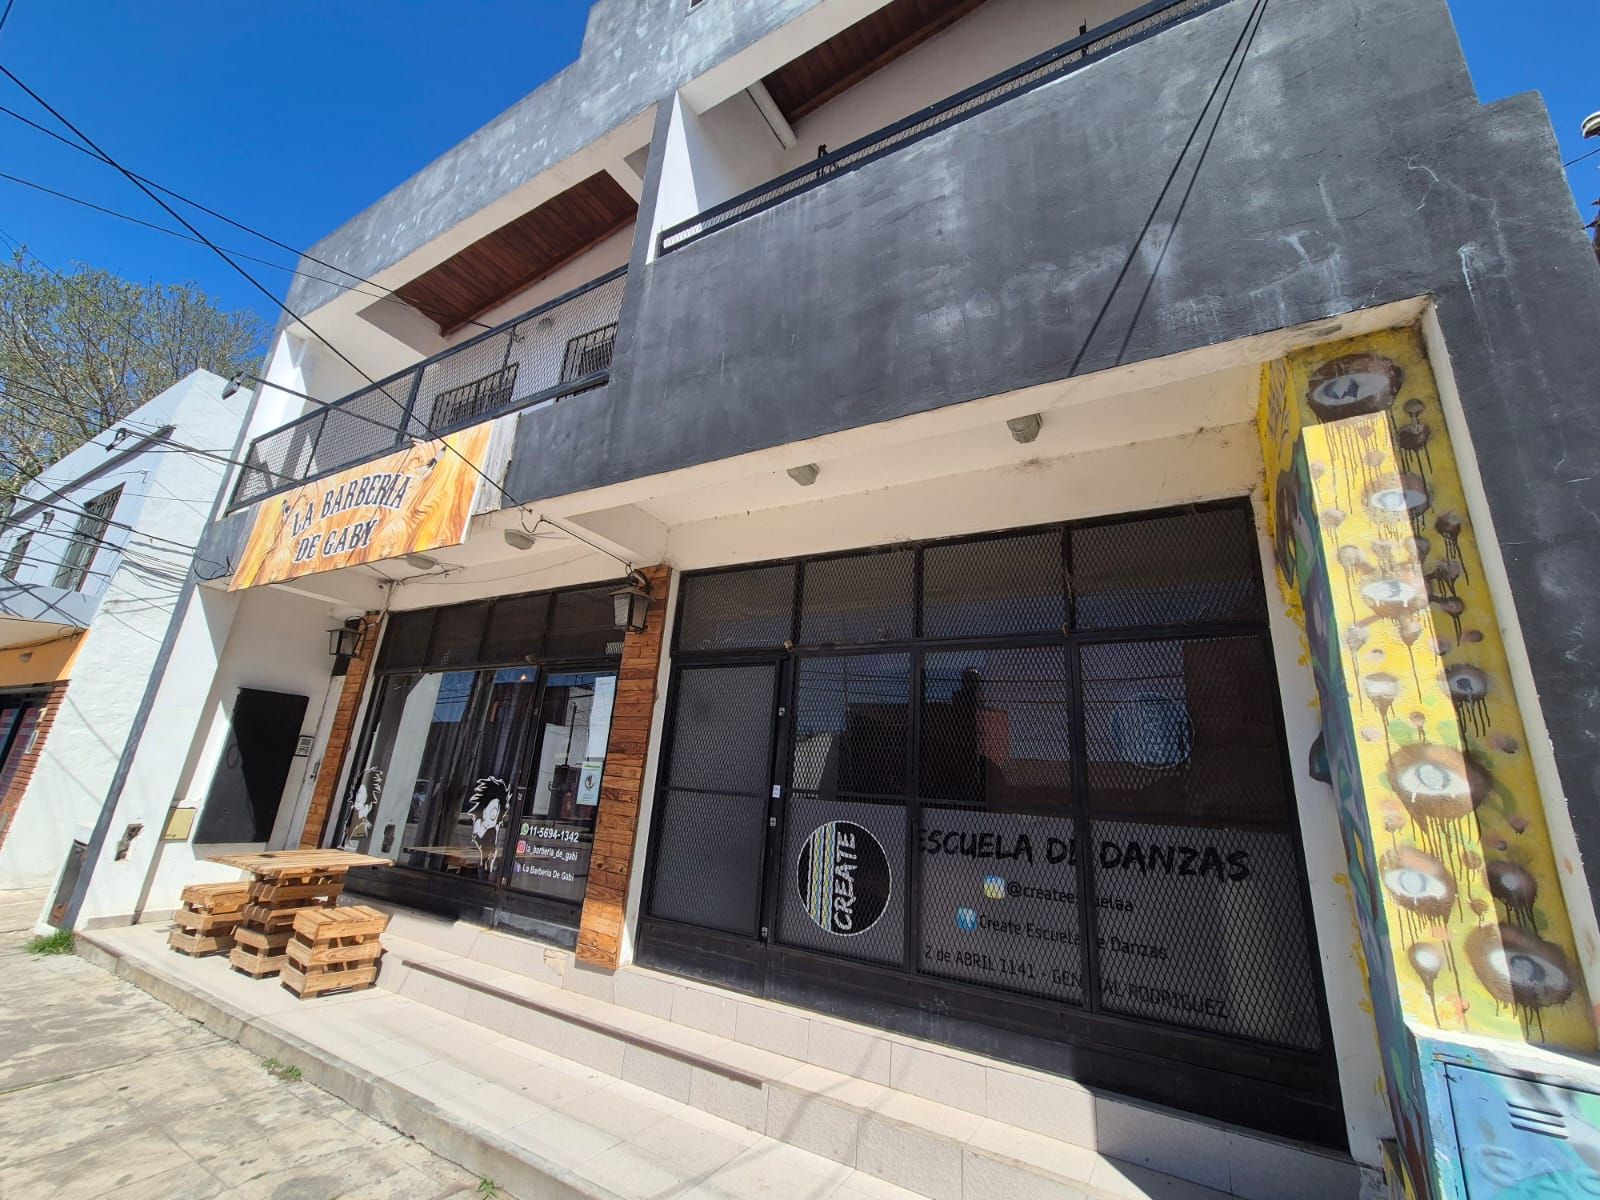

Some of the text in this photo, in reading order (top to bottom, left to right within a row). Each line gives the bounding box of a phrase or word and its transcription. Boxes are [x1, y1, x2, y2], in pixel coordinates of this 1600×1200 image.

[292, 473, 411, 537] LA BARBERIA
[294, 519, 378, 562] DE GABY
[529, 825, 579, 843] 11-5694-1342
[919, 829, 1033, 865] ESCUELA
[1101, 841, 1250, 882] DANZAS
[834, 831, 858, 931] CREATE
[979, 914, 1021, 935] Create
[1111, 937, 1168, 960] Danzas
[925, 945, 932, 959] 2
[956, 951, 995, 971] ABRIL
[1000, 958, 1036, 979] 1141
